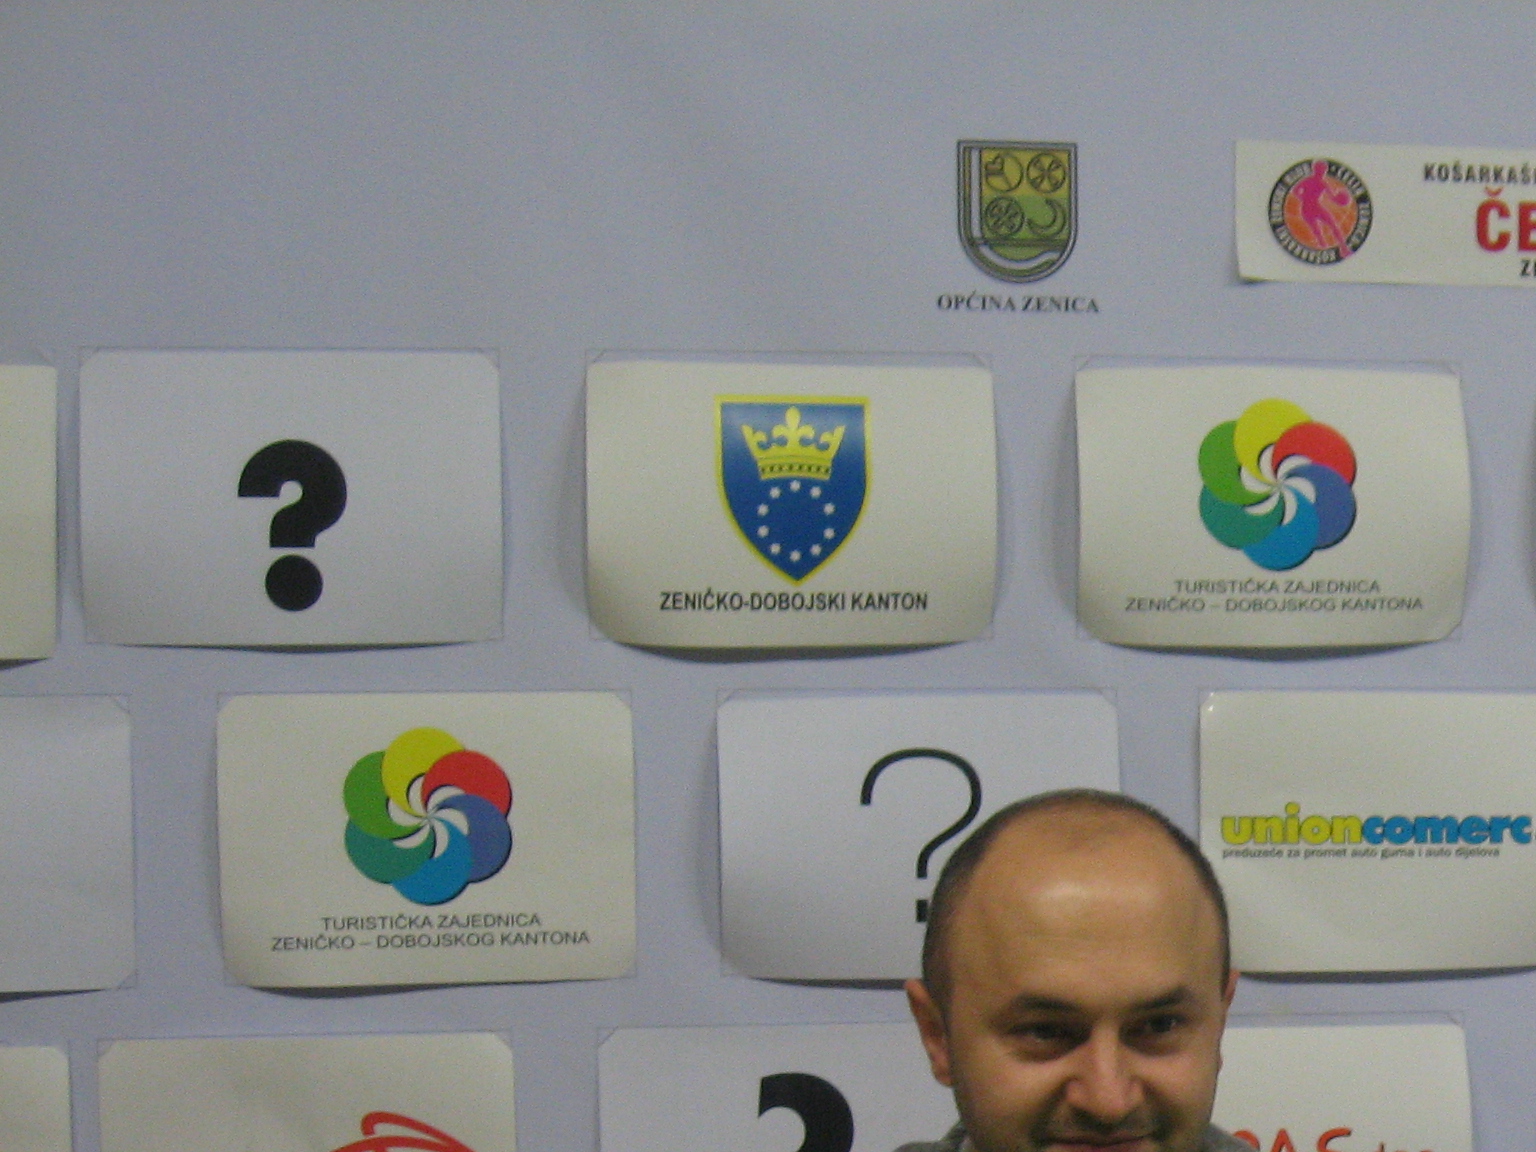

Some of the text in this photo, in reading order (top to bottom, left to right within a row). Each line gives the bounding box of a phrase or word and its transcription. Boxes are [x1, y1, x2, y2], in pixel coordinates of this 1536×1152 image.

[1021, 296, 1099, 313] ZENICA
[1283, 579, 1381, 594] ZAJEDNICA
[851, 592, 928, 612] KANTON
[1225, 599, 1336, 613] DOBOJSKOG
[1341, 598, 1424, 613] KANTONA
[437, 913, 541, 929] ZAJEDNICA
[376, 933, 495, 949] DOBOJSKOG
[500, 930, 590, 947] KANTONA
